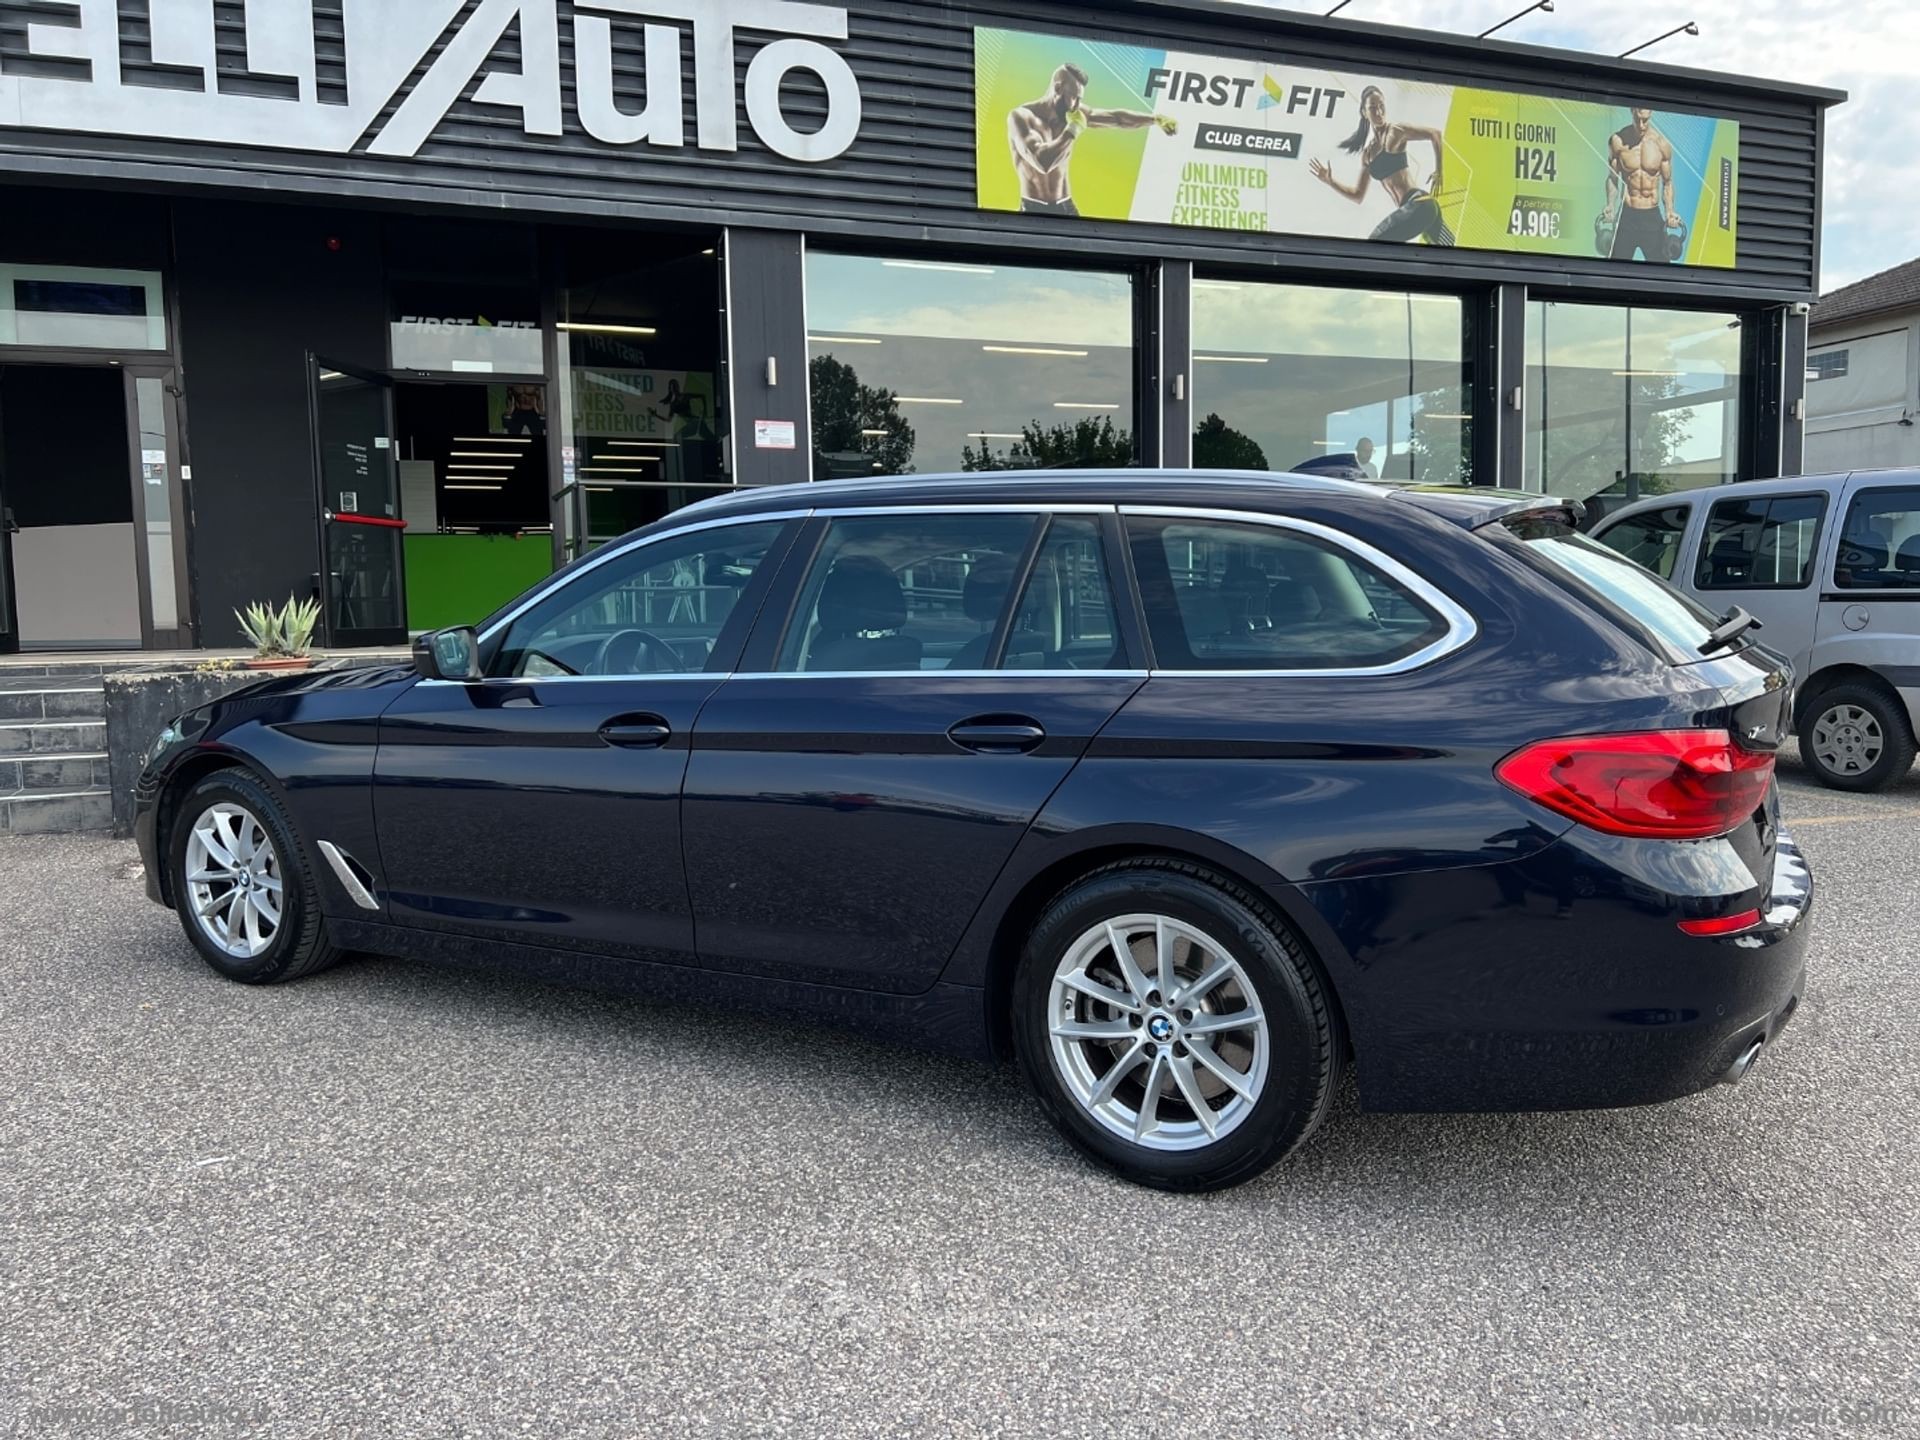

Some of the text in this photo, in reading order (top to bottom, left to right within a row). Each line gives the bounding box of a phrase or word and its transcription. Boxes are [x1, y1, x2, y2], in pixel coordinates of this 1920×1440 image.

[1144, 67, 1346, 119] FIRST FIT
[1205, 130, 1293, 153] CLUB CEREA
[1470, 117, 1556, 145] TUTTI I GIORNI
[1182, 160, 1268, 190] UNLIMITED
[1515, 146, 1557, 182] H24
[1176, 184, 1240, 209] FITNESS
[1171, 205, 1268, 232] EXPERIENCE
[1511, 208, 1560, 239] 9.90€
[401, 315, 536, 338] FIRST FIT
